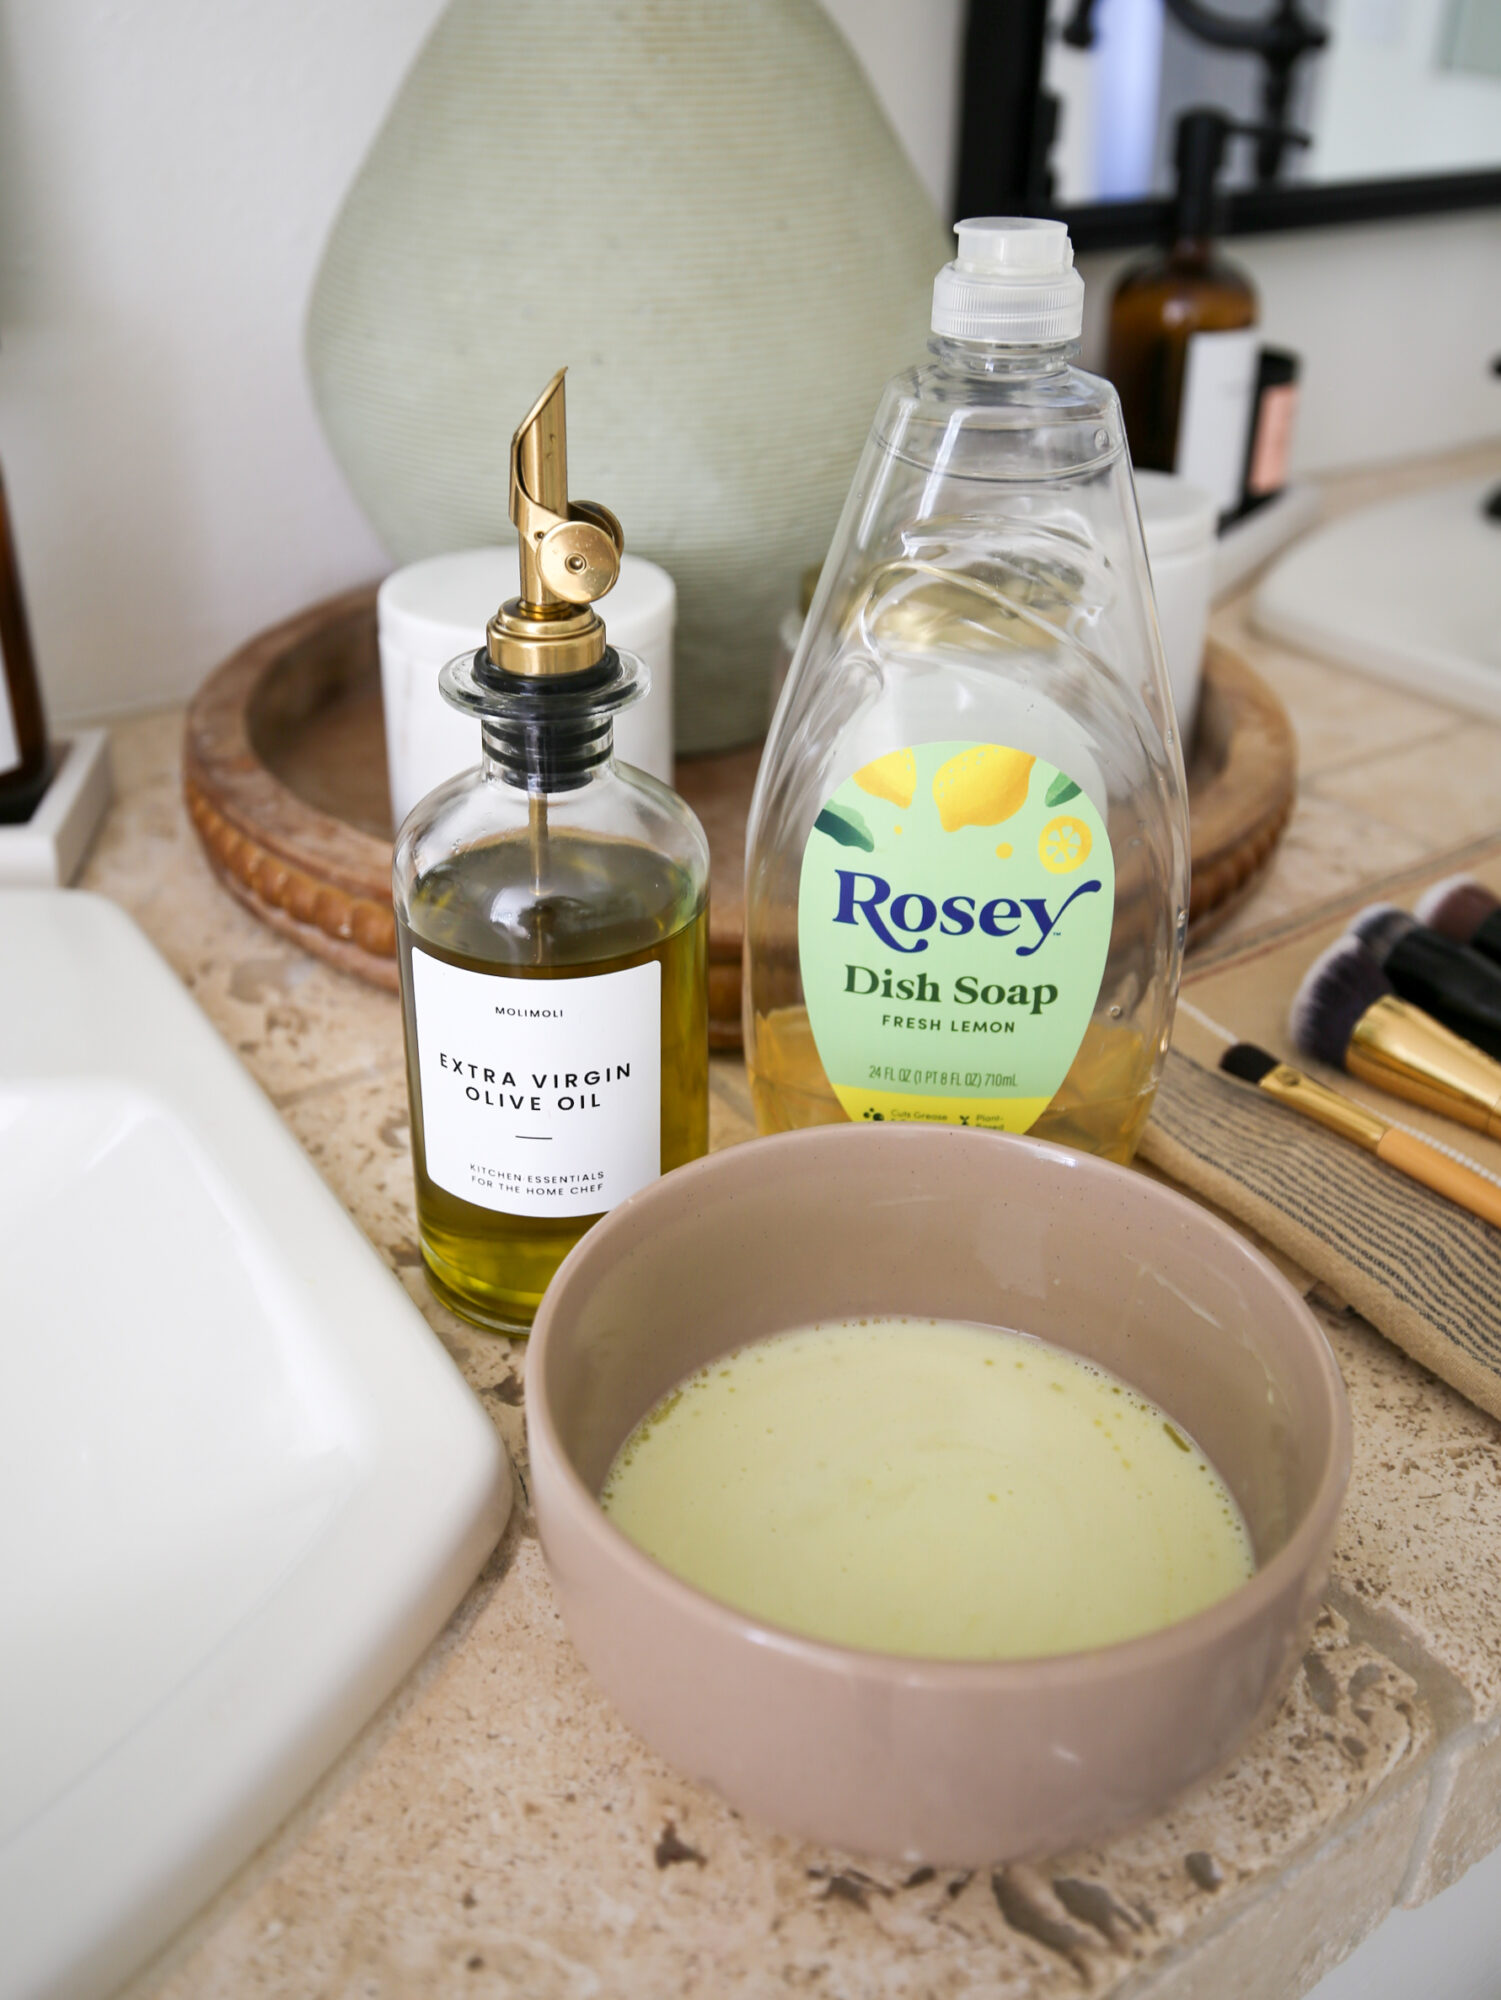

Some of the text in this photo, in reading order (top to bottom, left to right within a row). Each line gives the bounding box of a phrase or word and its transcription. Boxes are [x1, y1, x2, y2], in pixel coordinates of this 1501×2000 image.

[832, 868, 1102, 957] Rosey
[844, 964, 1059, 1015] Dish Soap
[495, 1006, 564, 1018] MOLIMOLI
[882, 1014, 1015, 1033] FRESH LEMON
[440, 1052, 631, 1089] EXTRA VIRGIN
[869, 1065, 881, 1079] 24
[885, 1066, 894, 1081] FL
[899, 1068, 911, 1083] OZ
[914, 1069, 922, 1085] (1
[925, 1070, 938, 1085] PT
[940, 1071, 948, 1085] 8
[950, 1072, 961, 1086] FL
[964, 1073, 982, 1088] OZ)
[465, 1087, 601, 1111] OLIVE OIL
[891, 1109, 948, 1121] Cuts Grease
[976, 1114, 1003, 1122] Plant-
[470, 1164, 604, 1184] KITCHEN ESSENTIALS
[471, 1175, 604, 1196] FOR THE HOME CHEF
